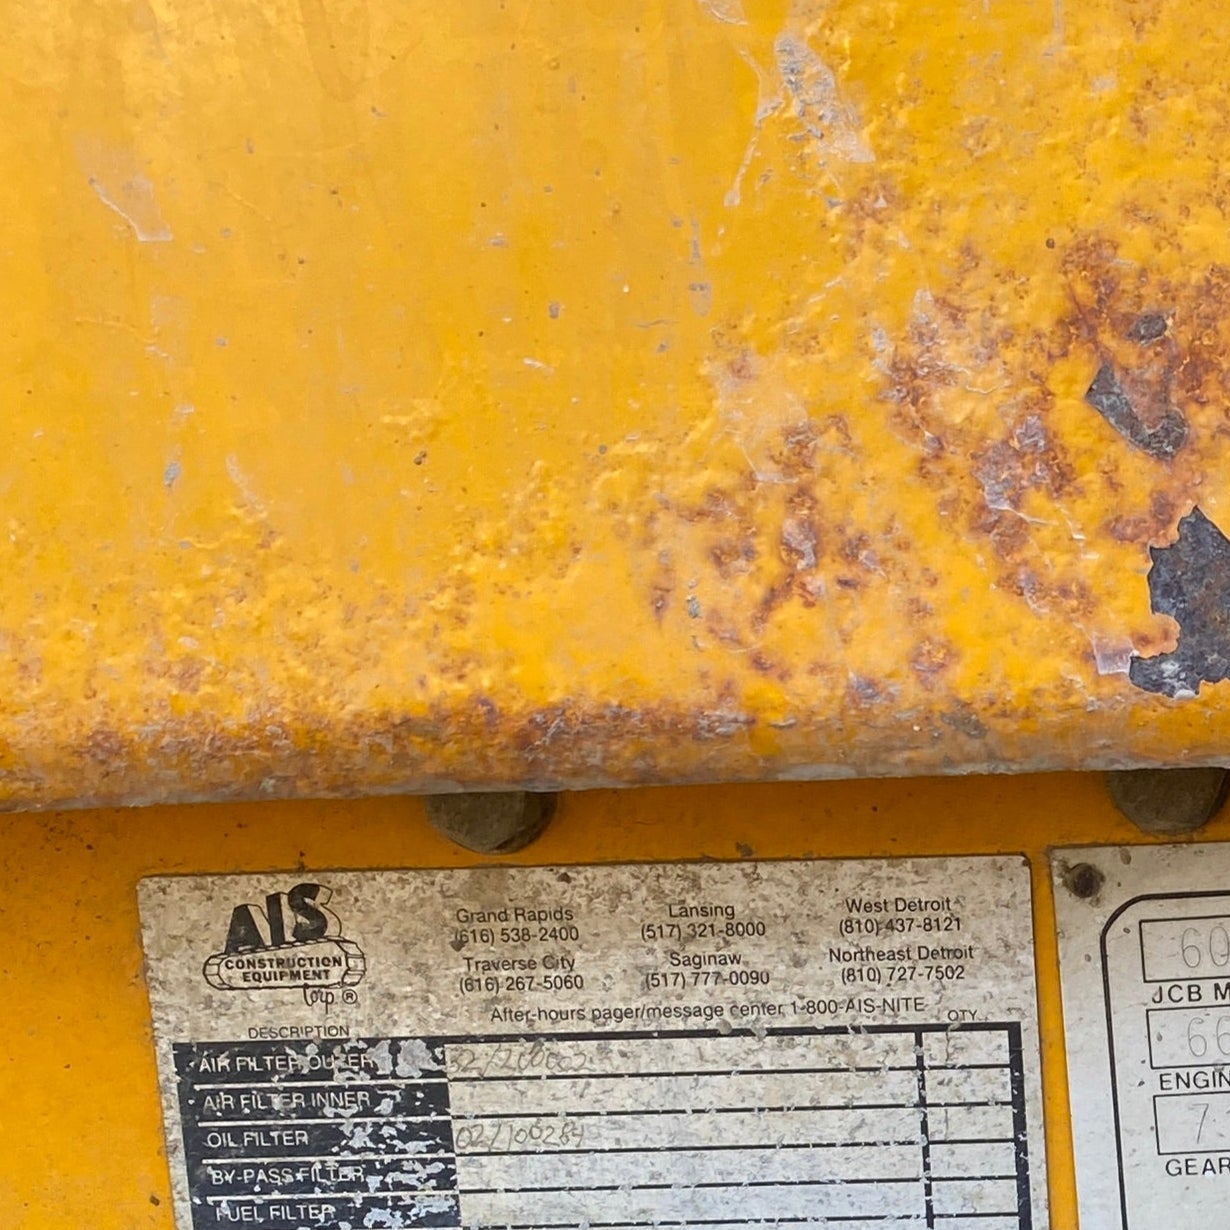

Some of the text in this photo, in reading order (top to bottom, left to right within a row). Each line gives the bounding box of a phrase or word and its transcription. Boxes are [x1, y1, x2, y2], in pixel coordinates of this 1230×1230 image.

[668, 903, 735, 921] Lansing
[844, 897, 951, 914] West Detroit
[225, 882, 342, 954] AIS
[456, 906, 574, 925] Grand Rapids
[454, 926, 580, 946] (616) 538-2400
[641, 921, 766, 942] (517) 321-8000
[839, 917, 962, 937] (810) 437-8121
[225, 956, 342, 970] CONSTRUCTION
[463, 954, 576, 972] Traverse City
[670, 950, 742, 969] Saginaw
[829, 945, 974, 962] Northeast Detroit
[243, 969, 330, 983] EQUIPMENT
[645, 970, 770, 990] (517) 777-0090
[841, 965, 966, 985] (810) 727-7502
[459, 974, 584, 996] (616) 267-5060
[1151, 984, 1202, 1005] JCB
[490, 996, 926, 1023] After-hours pager/message center 1-800-AIS-NITE
[248, 1025, 350, 1040] DESCRIPTION
[200, 1054, 374, 1073] AIR FILTER OUER
[203, 1091, 371, 1110] AIR FILTER INNER
[206, 1130, 309, 1148] OIL FILTER
[211, 1165, 365, 1185] BY-PASS FILTER
[215, 1203, 337, 1223] FUEL FILTER
